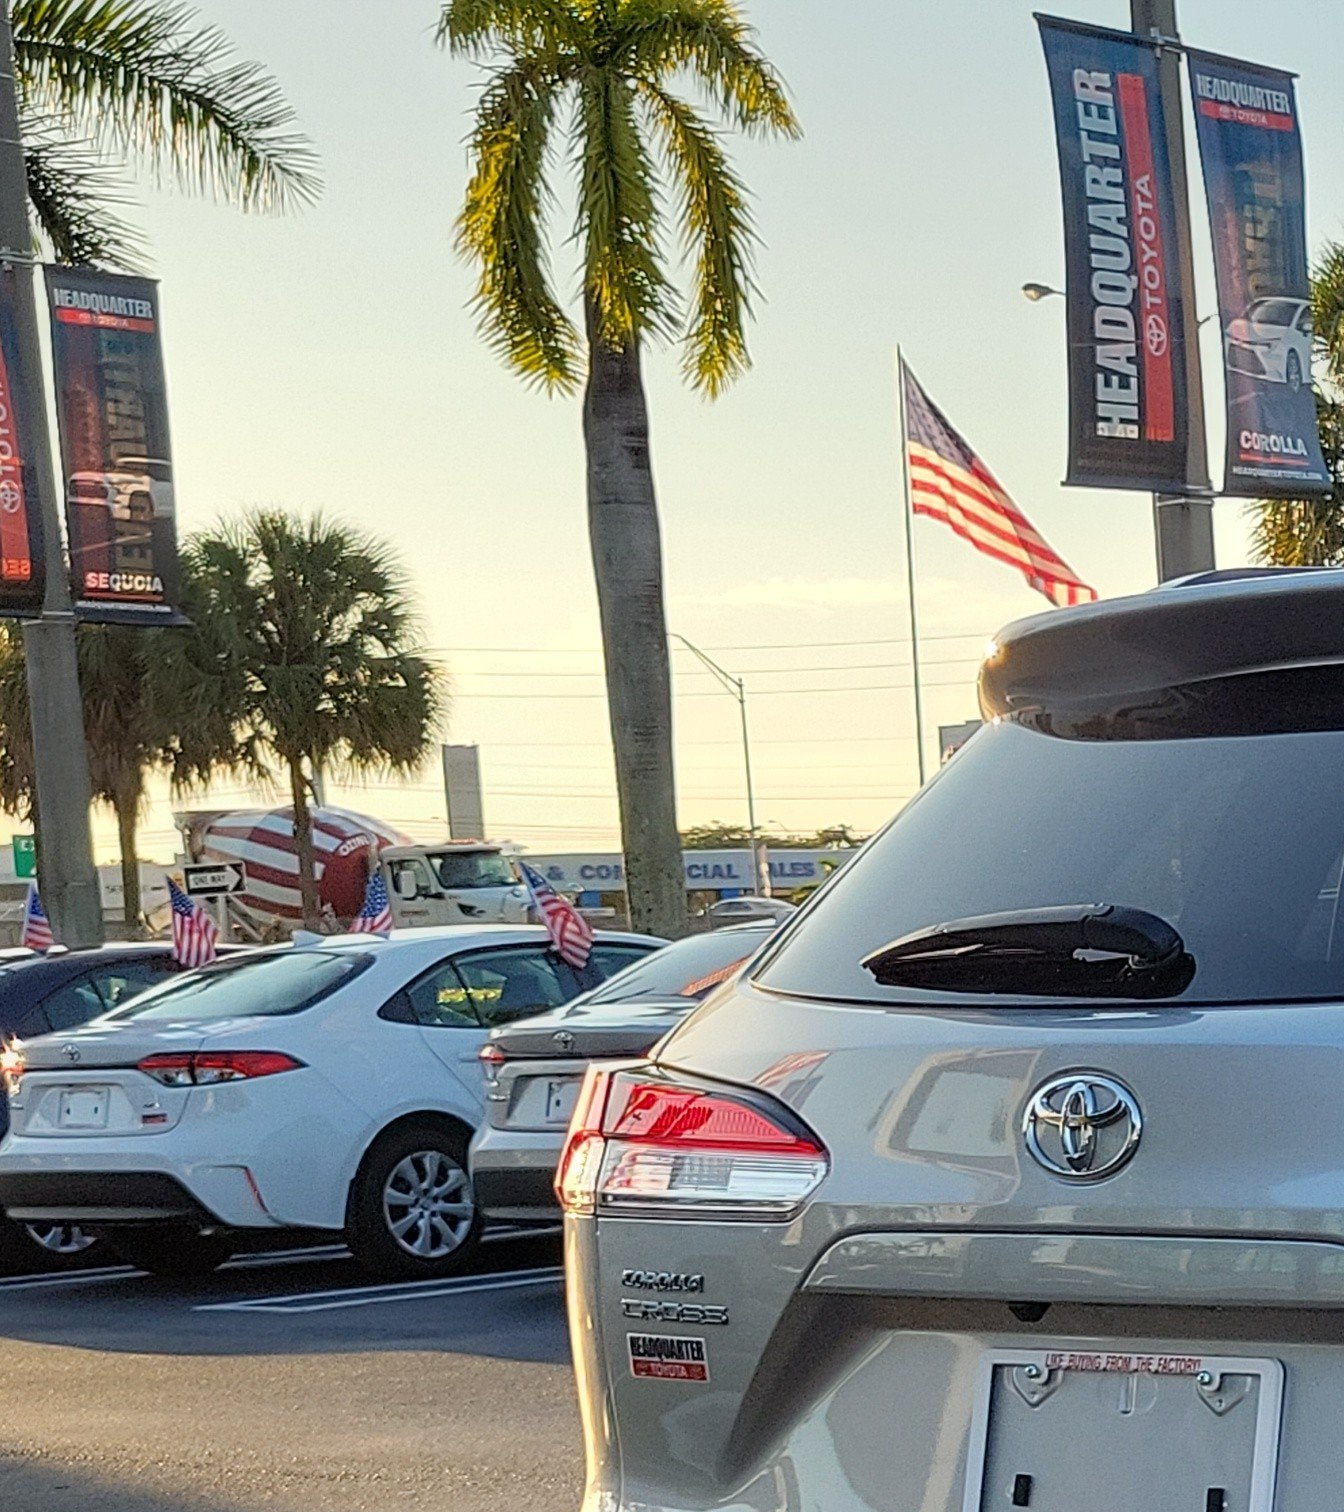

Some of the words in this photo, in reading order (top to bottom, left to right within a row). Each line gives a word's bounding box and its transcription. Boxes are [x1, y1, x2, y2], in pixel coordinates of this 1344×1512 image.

[1196, 74, 1291, 114] HEADQUARTER
[1232, 109, 1268, 125] TOYOTA
[1073, 69, 1138, 439] HEADQUARTER
[1135, 174, 1164, 309] TOYOTA
[54, 288, 153, 318] HEADQUARTER
[1240, 430, 1308, 456] COROLLA
[85, 571, 164, 592] SEQUOIA
[621, 1297, 730, 1326] CROSS
[629, 1335, 705, 1362] HEADQUARTER
[1067, 1354, 1101, 1371] BUYING
[1105, 1355, 1133, 1373] FROM
[1136, 1356, 1153, 1372] THE
